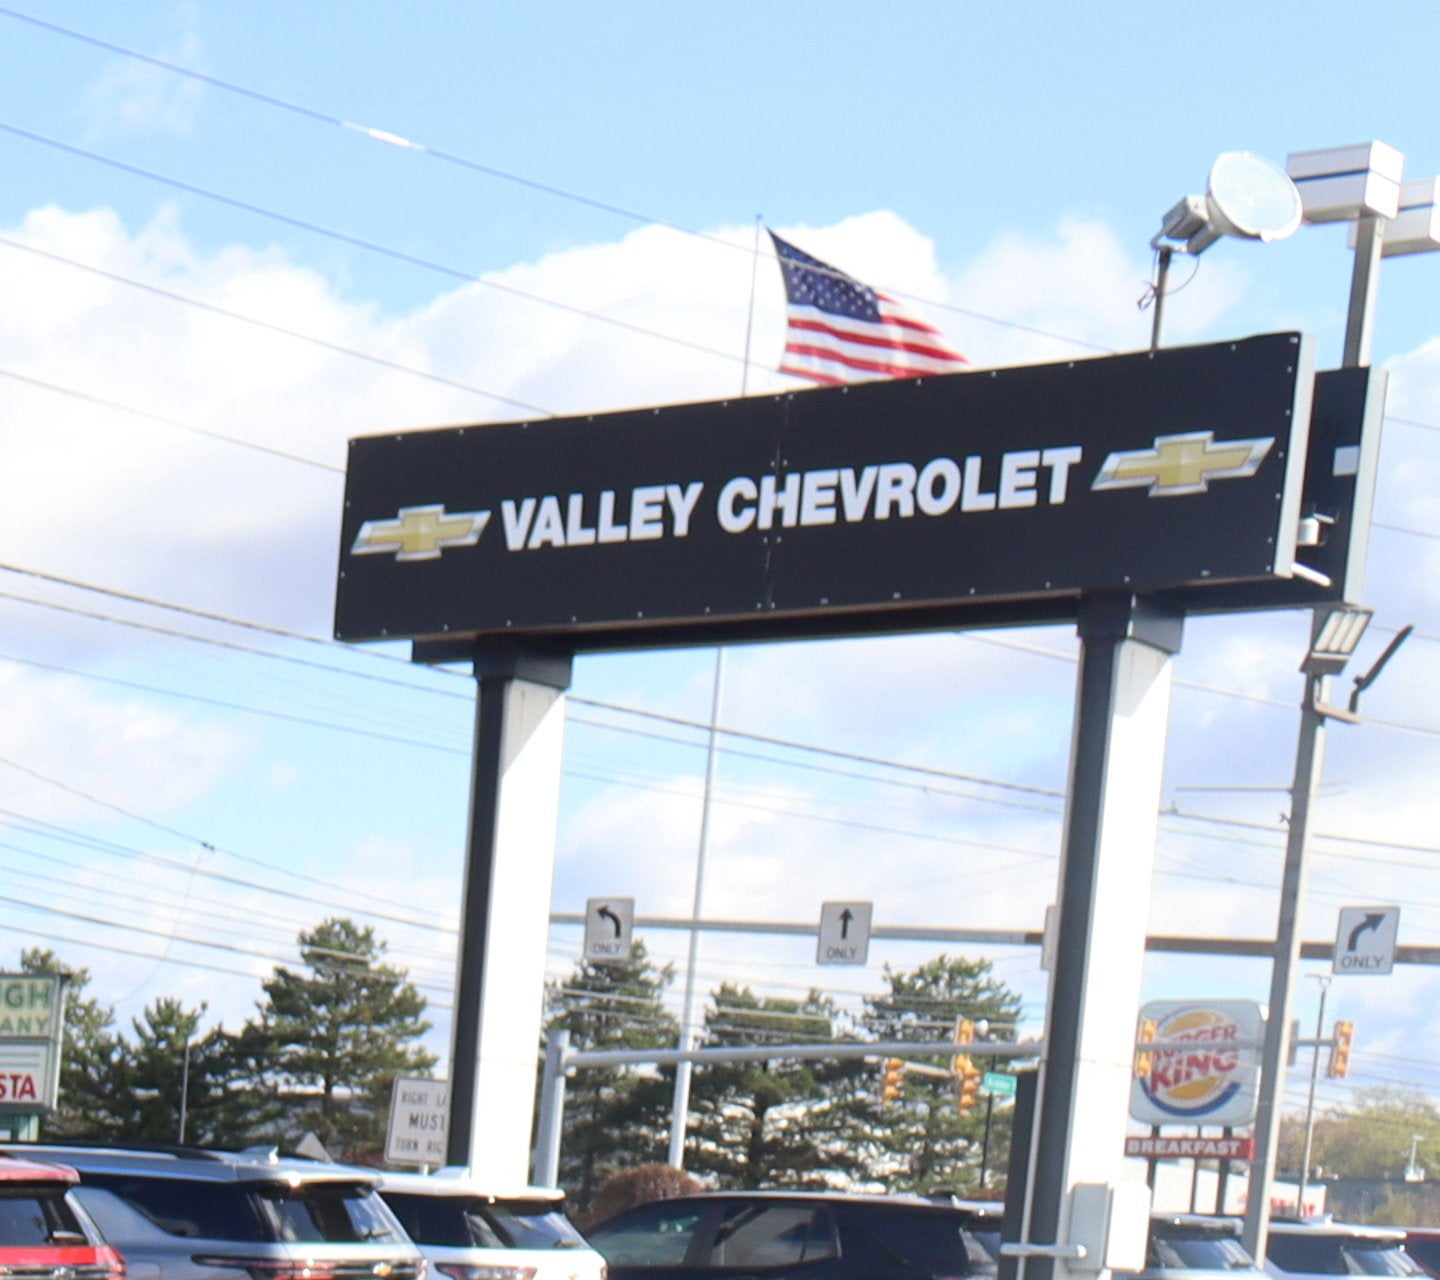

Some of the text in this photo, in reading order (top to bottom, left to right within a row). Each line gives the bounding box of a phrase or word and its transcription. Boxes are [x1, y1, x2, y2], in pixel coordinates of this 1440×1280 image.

[502, 446, 1084, 551] VALLEY CHEVROLET
[592, 943, 622, 955] ONLY
[826, 946, 858, 960] ONLY
[1340, 954, 1385, 969] ONLY
[1150, 1049, 1239, 1093] KING
[401, 1090, 429, 1106] RIGHT
[1127, 1138, 1242, 1156] BREAKFAST
